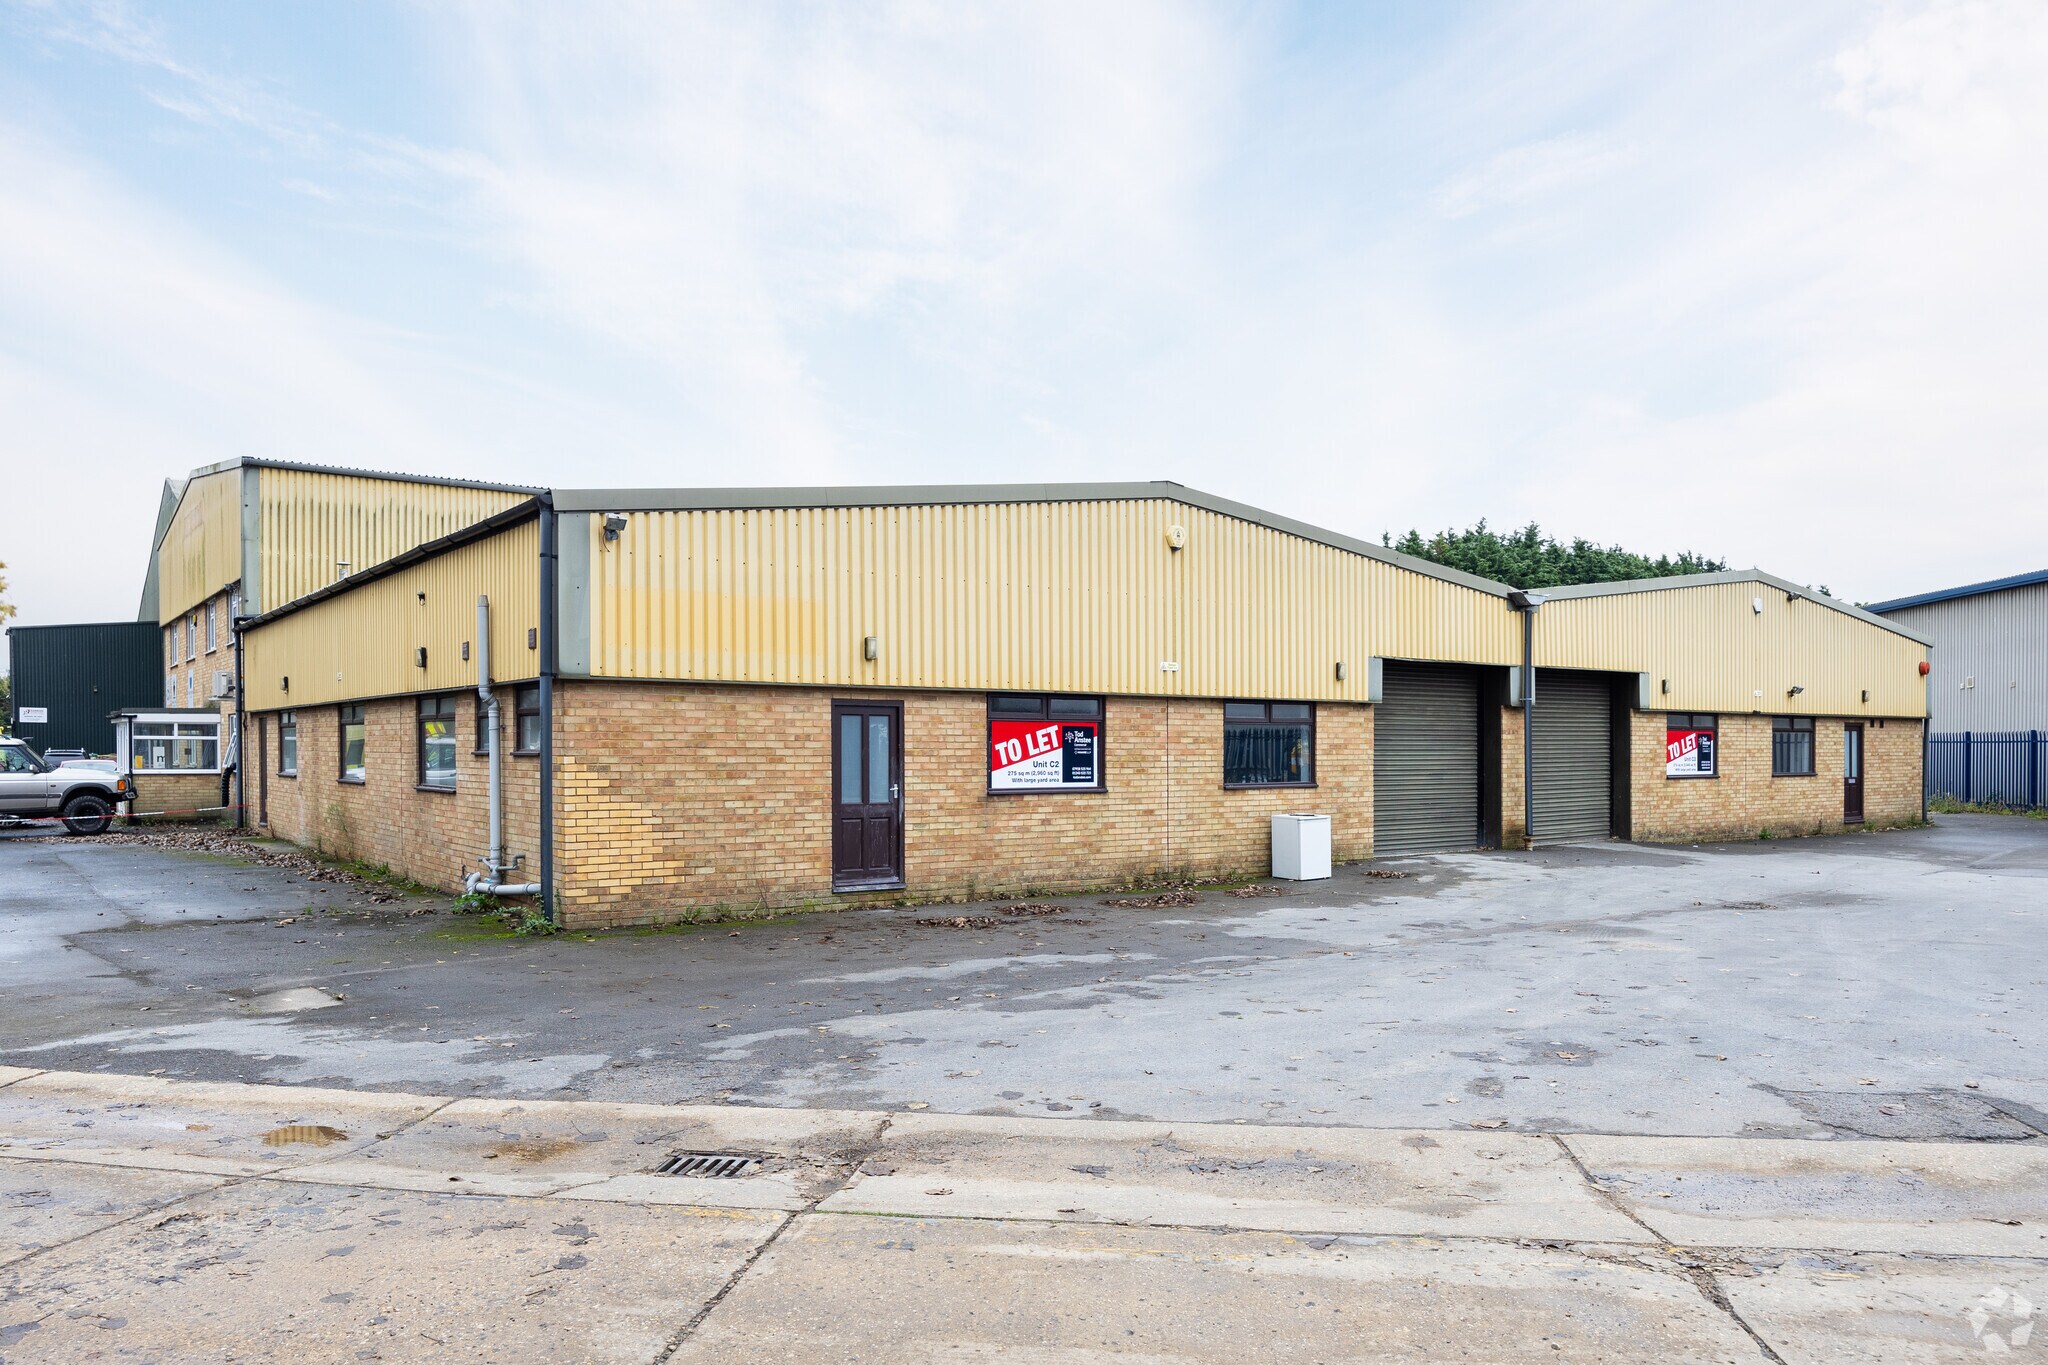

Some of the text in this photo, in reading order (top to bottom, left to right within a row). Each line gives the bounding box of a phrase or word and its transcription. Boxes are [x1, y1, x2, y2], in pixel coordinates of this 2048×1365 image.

[994, 724, 1058, 765] TO LET
[1668, 733, 1696, 760] TO LET
